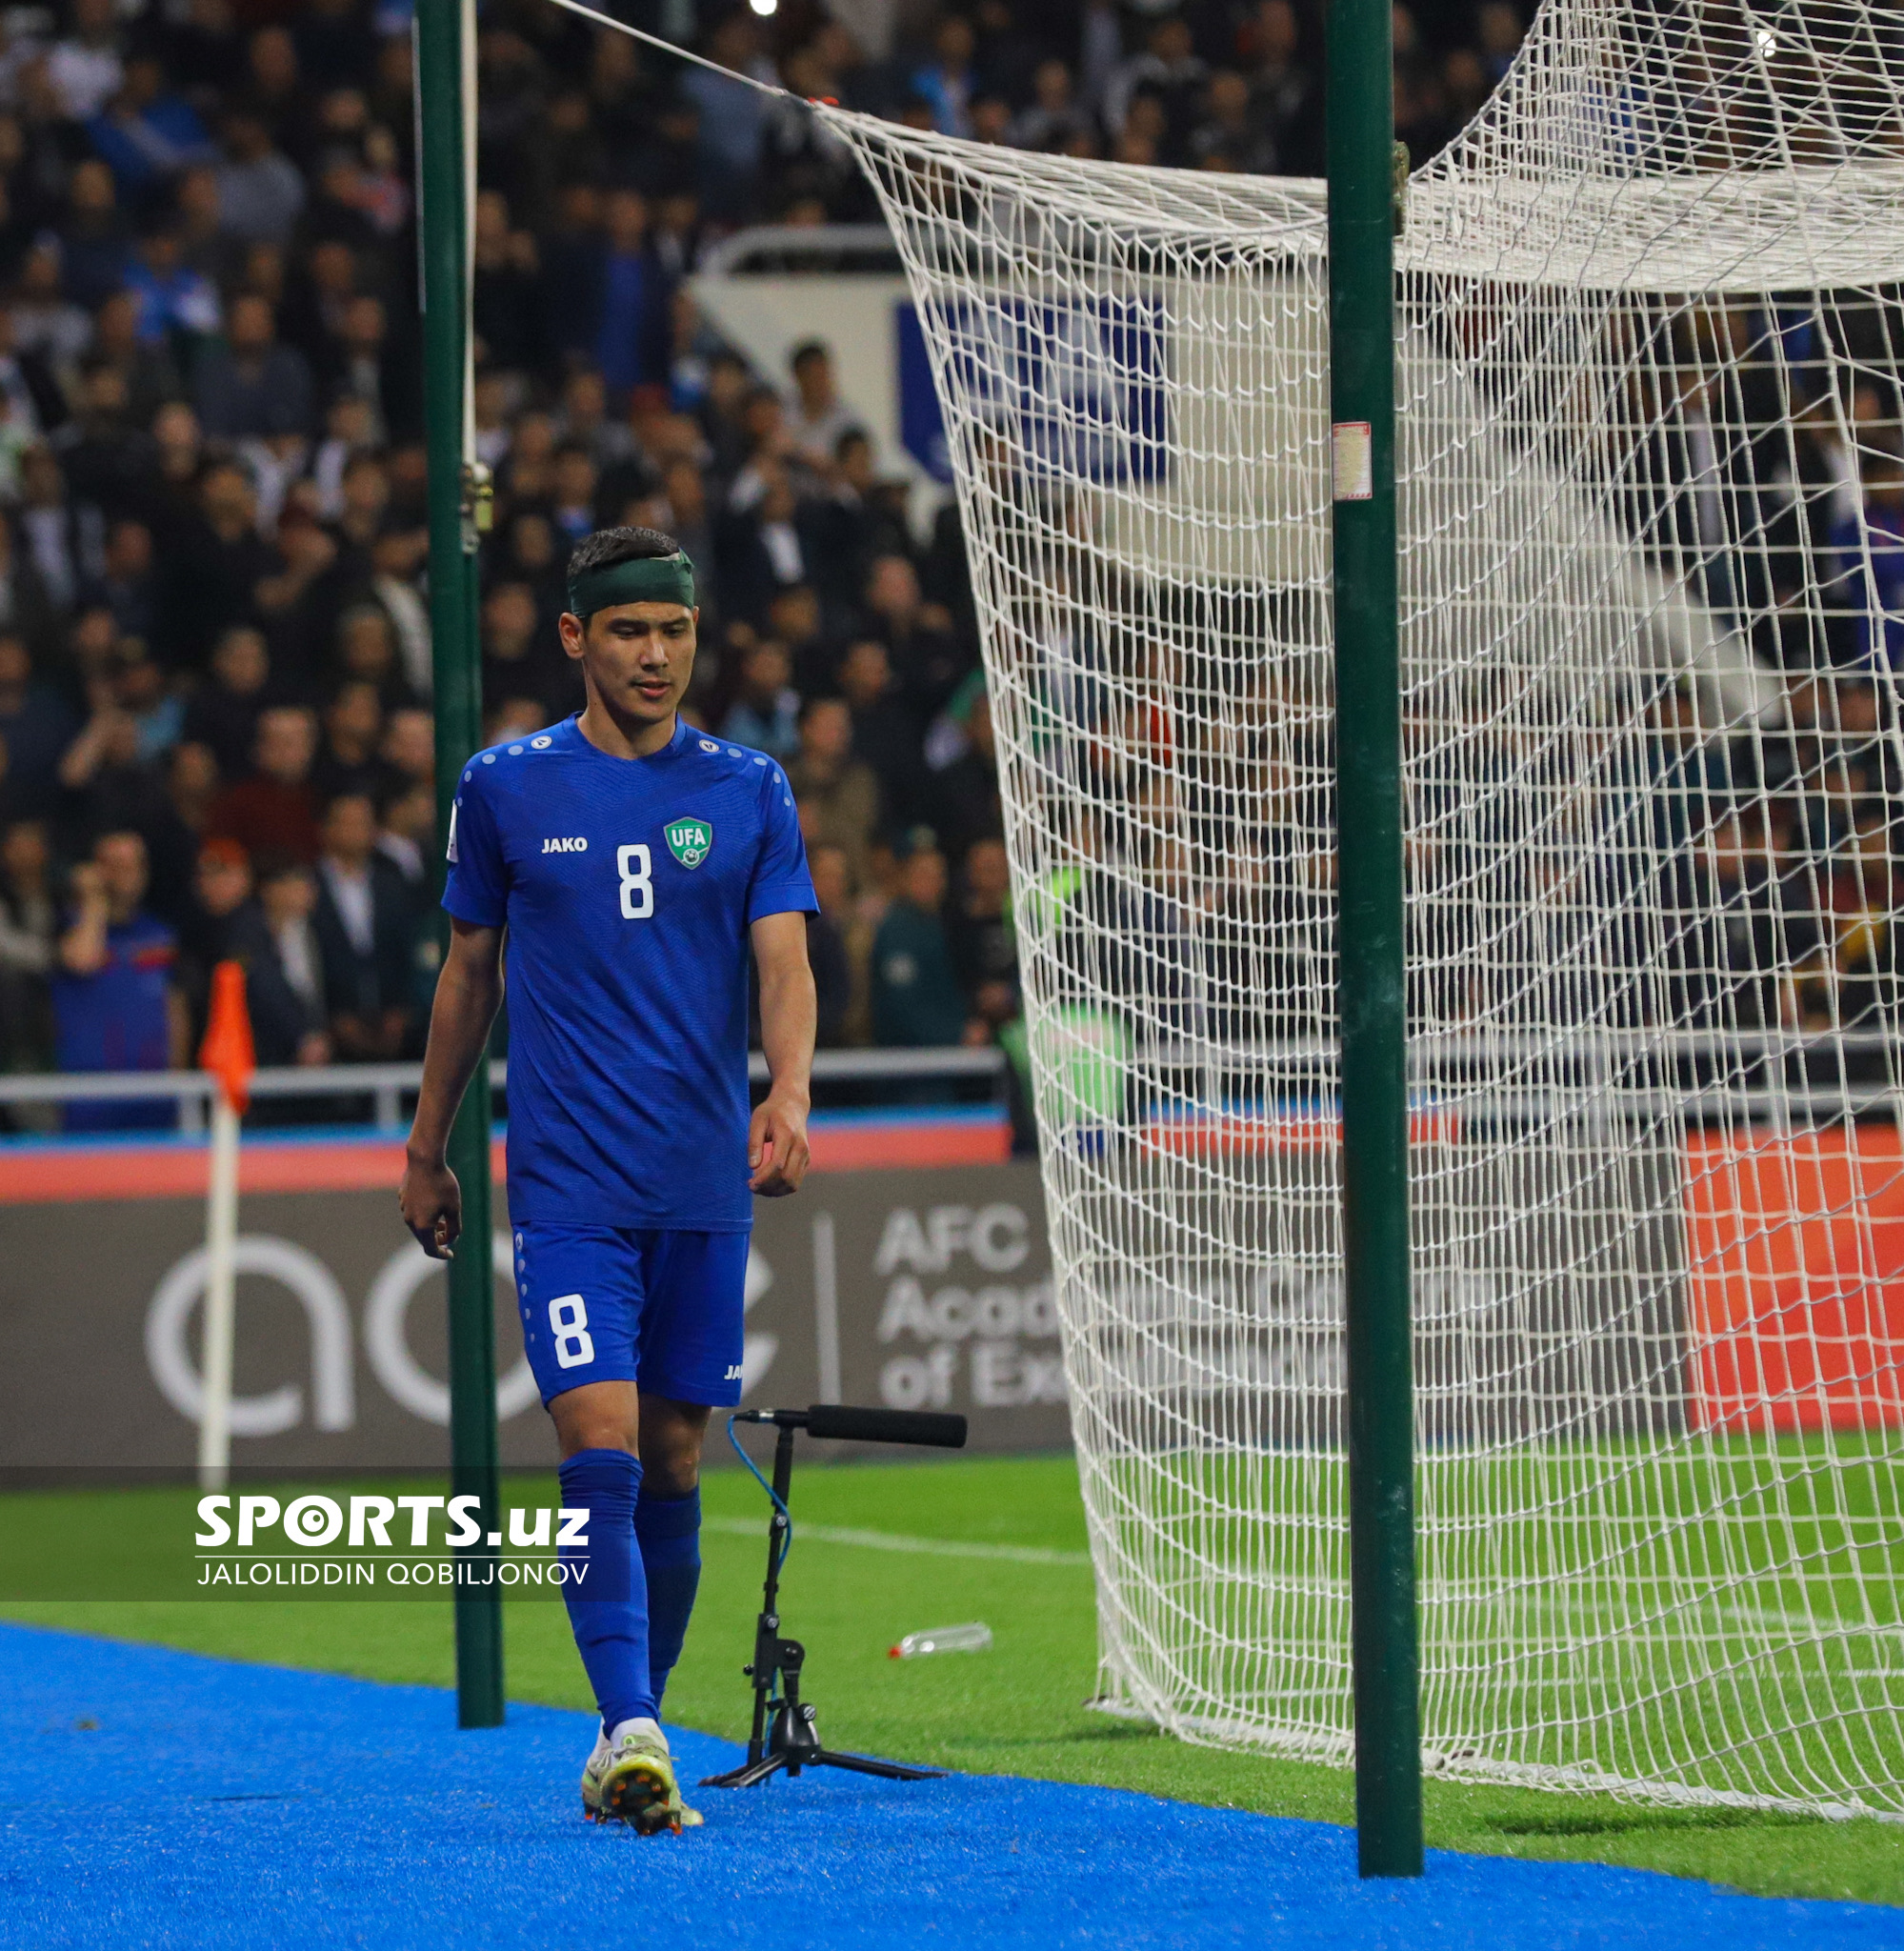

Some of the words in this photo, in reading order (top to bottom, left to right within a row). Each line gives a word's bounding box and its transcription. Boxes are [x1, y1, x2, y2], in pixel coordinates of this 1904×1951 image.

[541, 836, 589, 854] JAKO
[671, 828, 707, 847] UFA
[616, 843, 654, 919] 8
[874, 1202, 1030, 1273] AFC
[548, 1293, 595, 1369] 8
[878, 1343, 957, 1411] of
